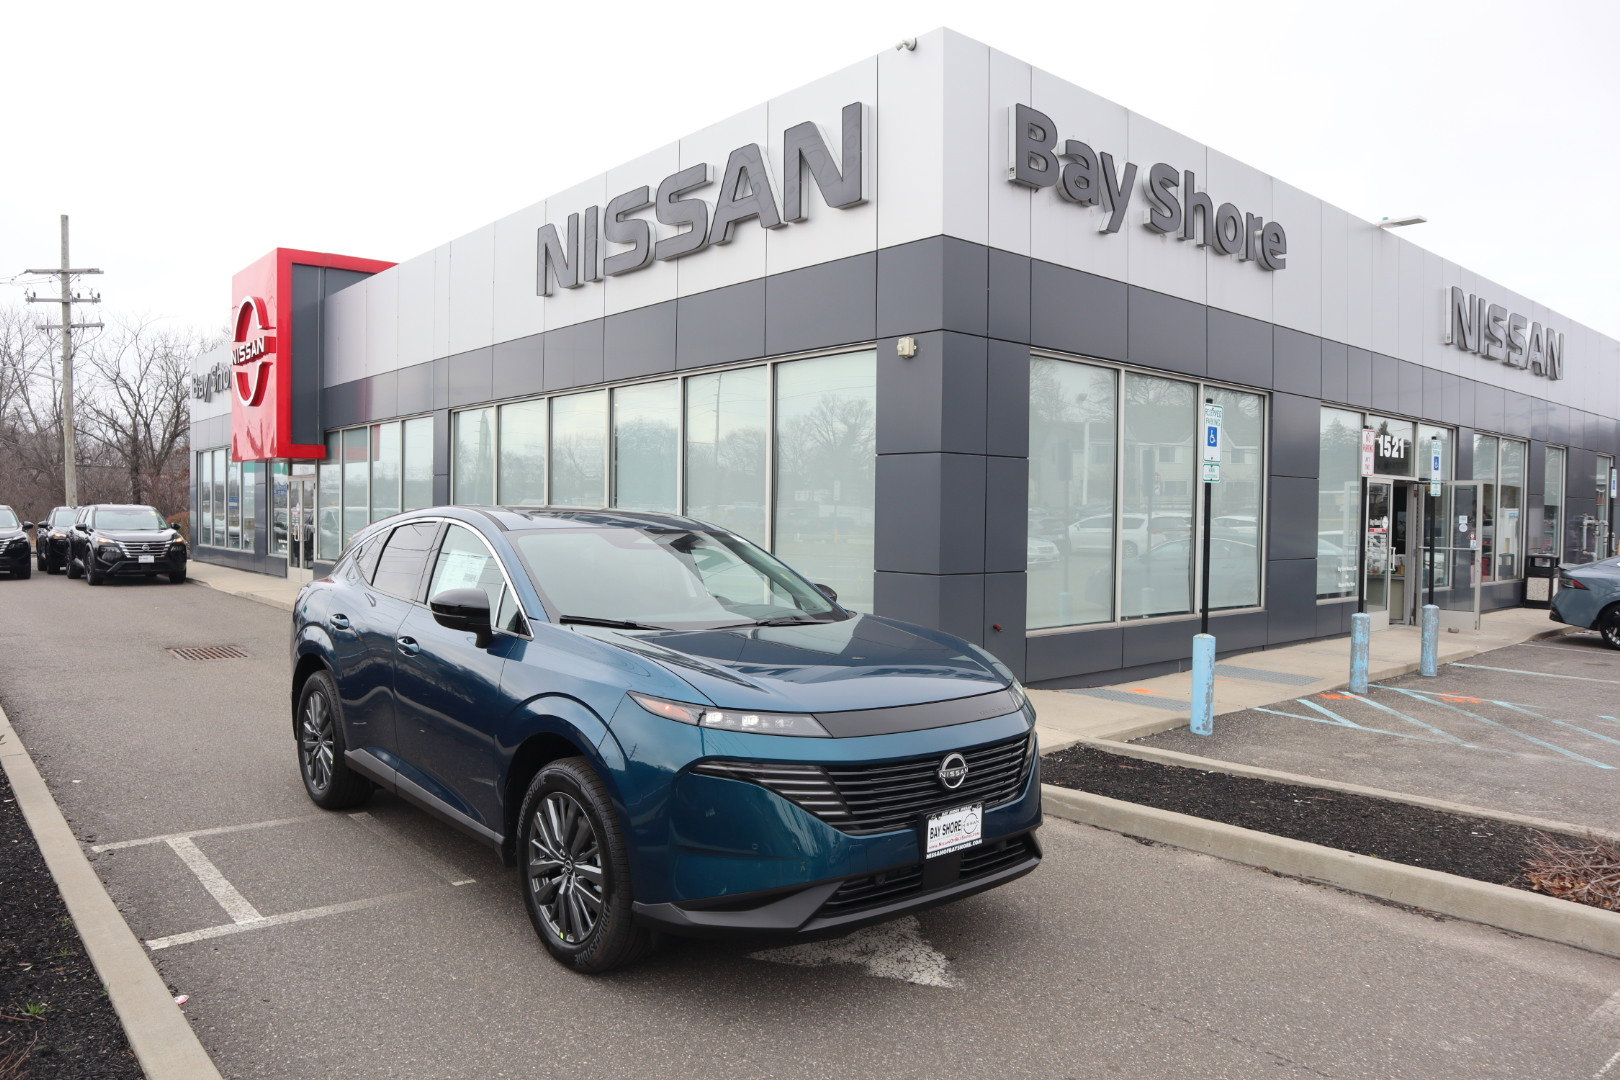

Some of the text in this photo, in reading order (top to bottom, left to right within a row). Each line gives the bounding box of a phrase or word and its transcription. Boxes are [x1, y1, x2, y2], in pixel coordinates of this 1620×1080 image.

[537, 102, 868, 297] NISSAN
[1008, 103, 1287, 271] Bay Shore
[1445, 286, 1565, 381] NISSAN
[232, 337, 265, 365] NISSAN
[192, 362, 232, 402] Bay Sho
[1379, 435, 1404, 458] 1521
[939, 766, 969, 778] NISSAN
[930, 820, 962, 839] BAY SHORE
